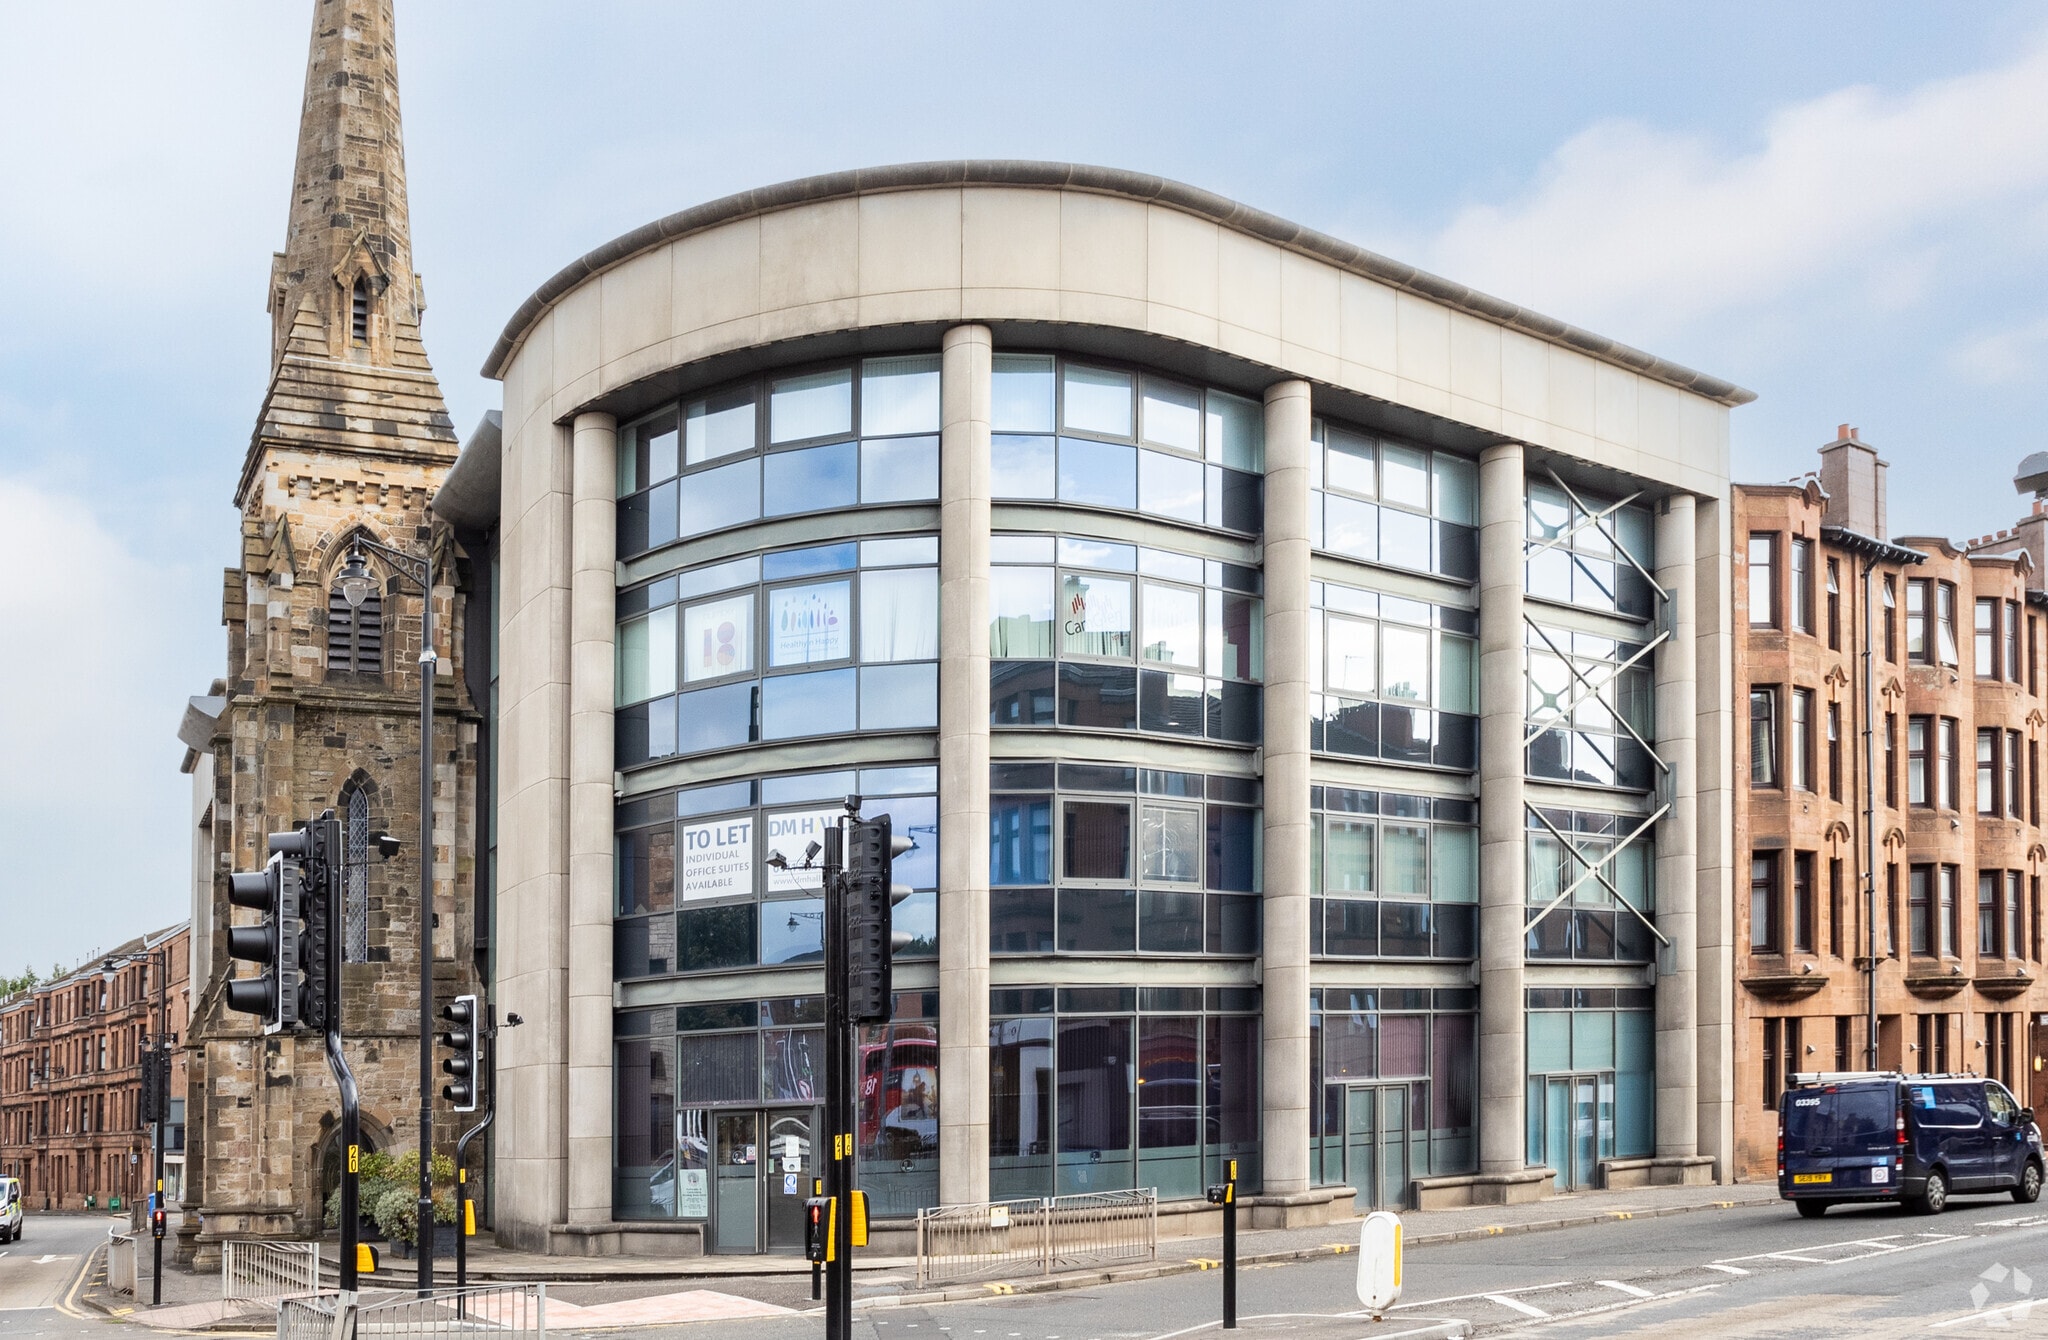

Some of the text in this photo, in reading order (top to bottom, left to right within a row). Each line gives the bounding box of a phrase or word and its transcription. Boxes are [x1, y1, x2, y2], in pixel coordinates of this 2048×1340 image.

[769, 819, 797, 837] DM
[686, 824, 751, 850] TO LET
[686, 849, 740, 864] INDIVIDUAL
[686, 862, 750, 878] OFFICE SUITES
[686, 877, 734, 891] AVAILABLE
[350, 1145, 357, 1172] 20
